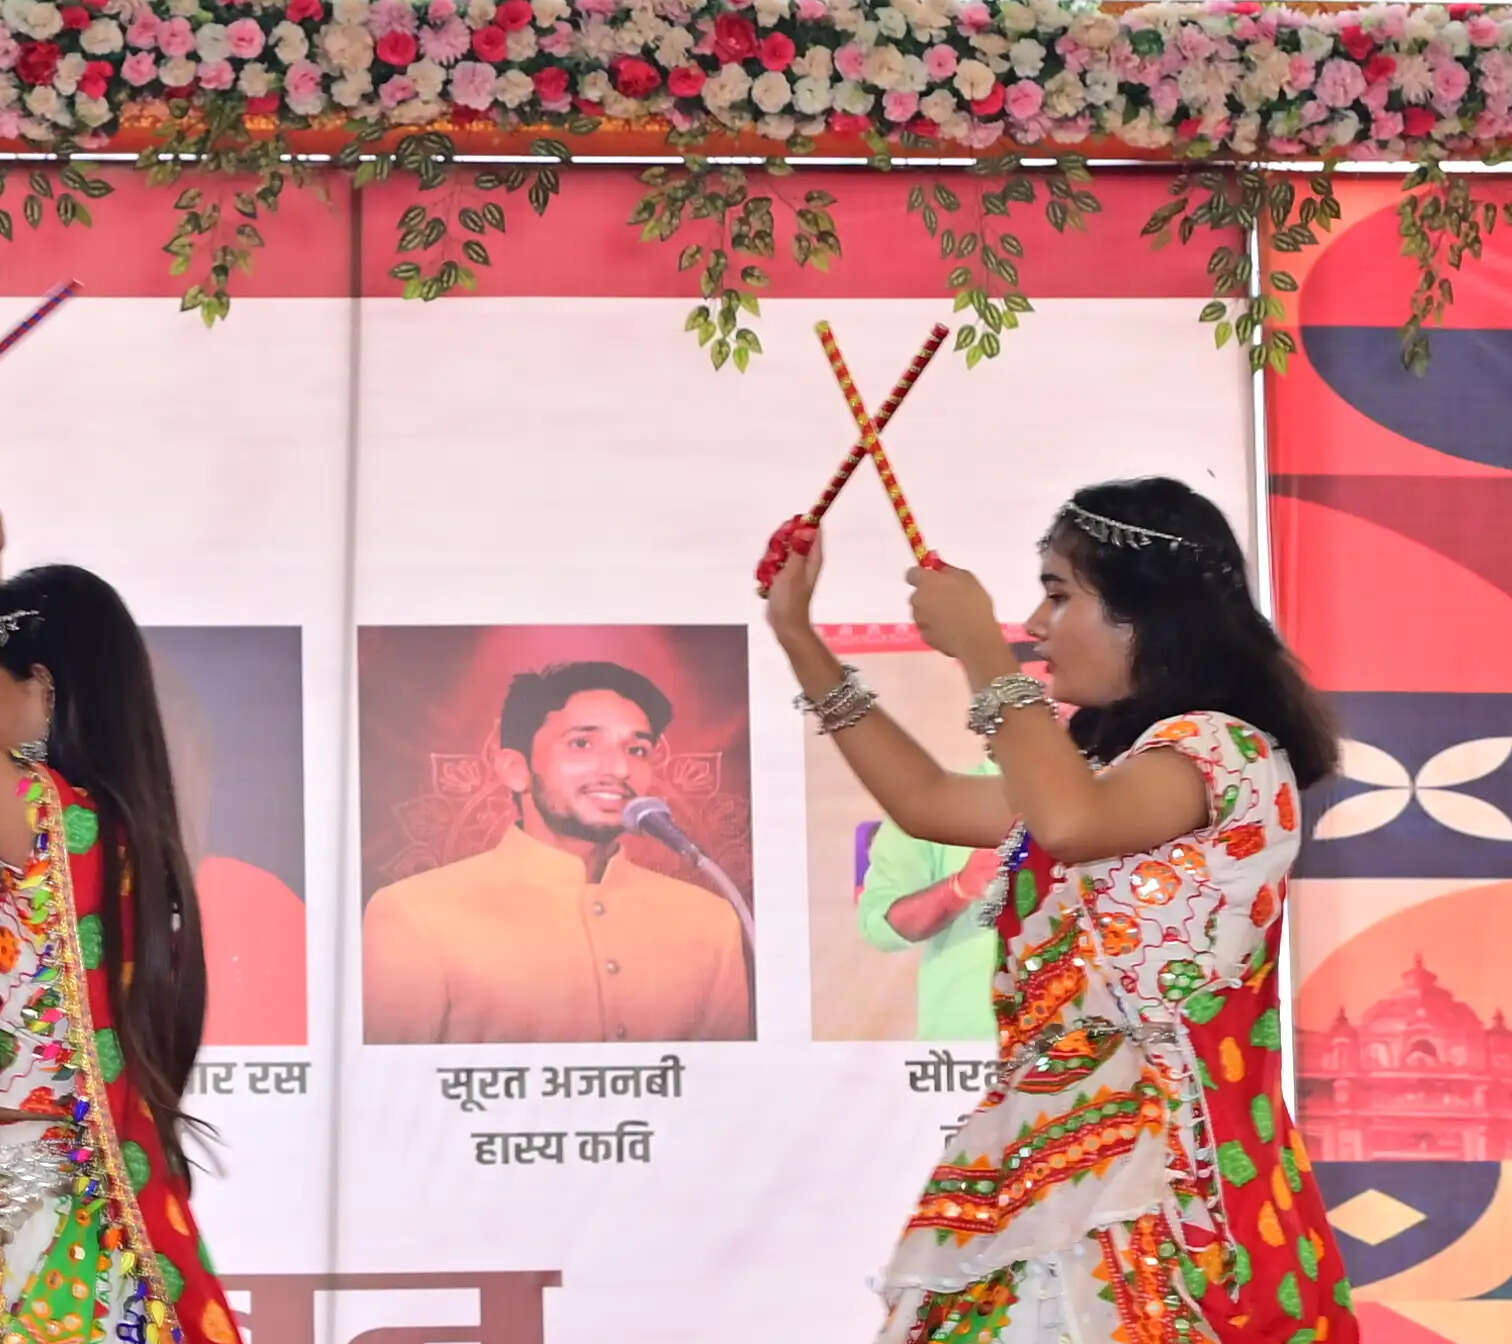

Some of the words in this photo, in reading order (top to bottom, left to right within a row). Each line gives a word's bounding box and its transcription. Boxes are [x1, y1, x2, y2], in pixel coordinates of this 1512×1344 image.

[243, 1061, 312, 1095] रस
[435, 1065, 531, 1113] सूरत
[540, 1053, 686, 1099] अजनबी
[469, 1130, 569, 1166] हास्य
[574, 1119, 655, 1164] कवि
